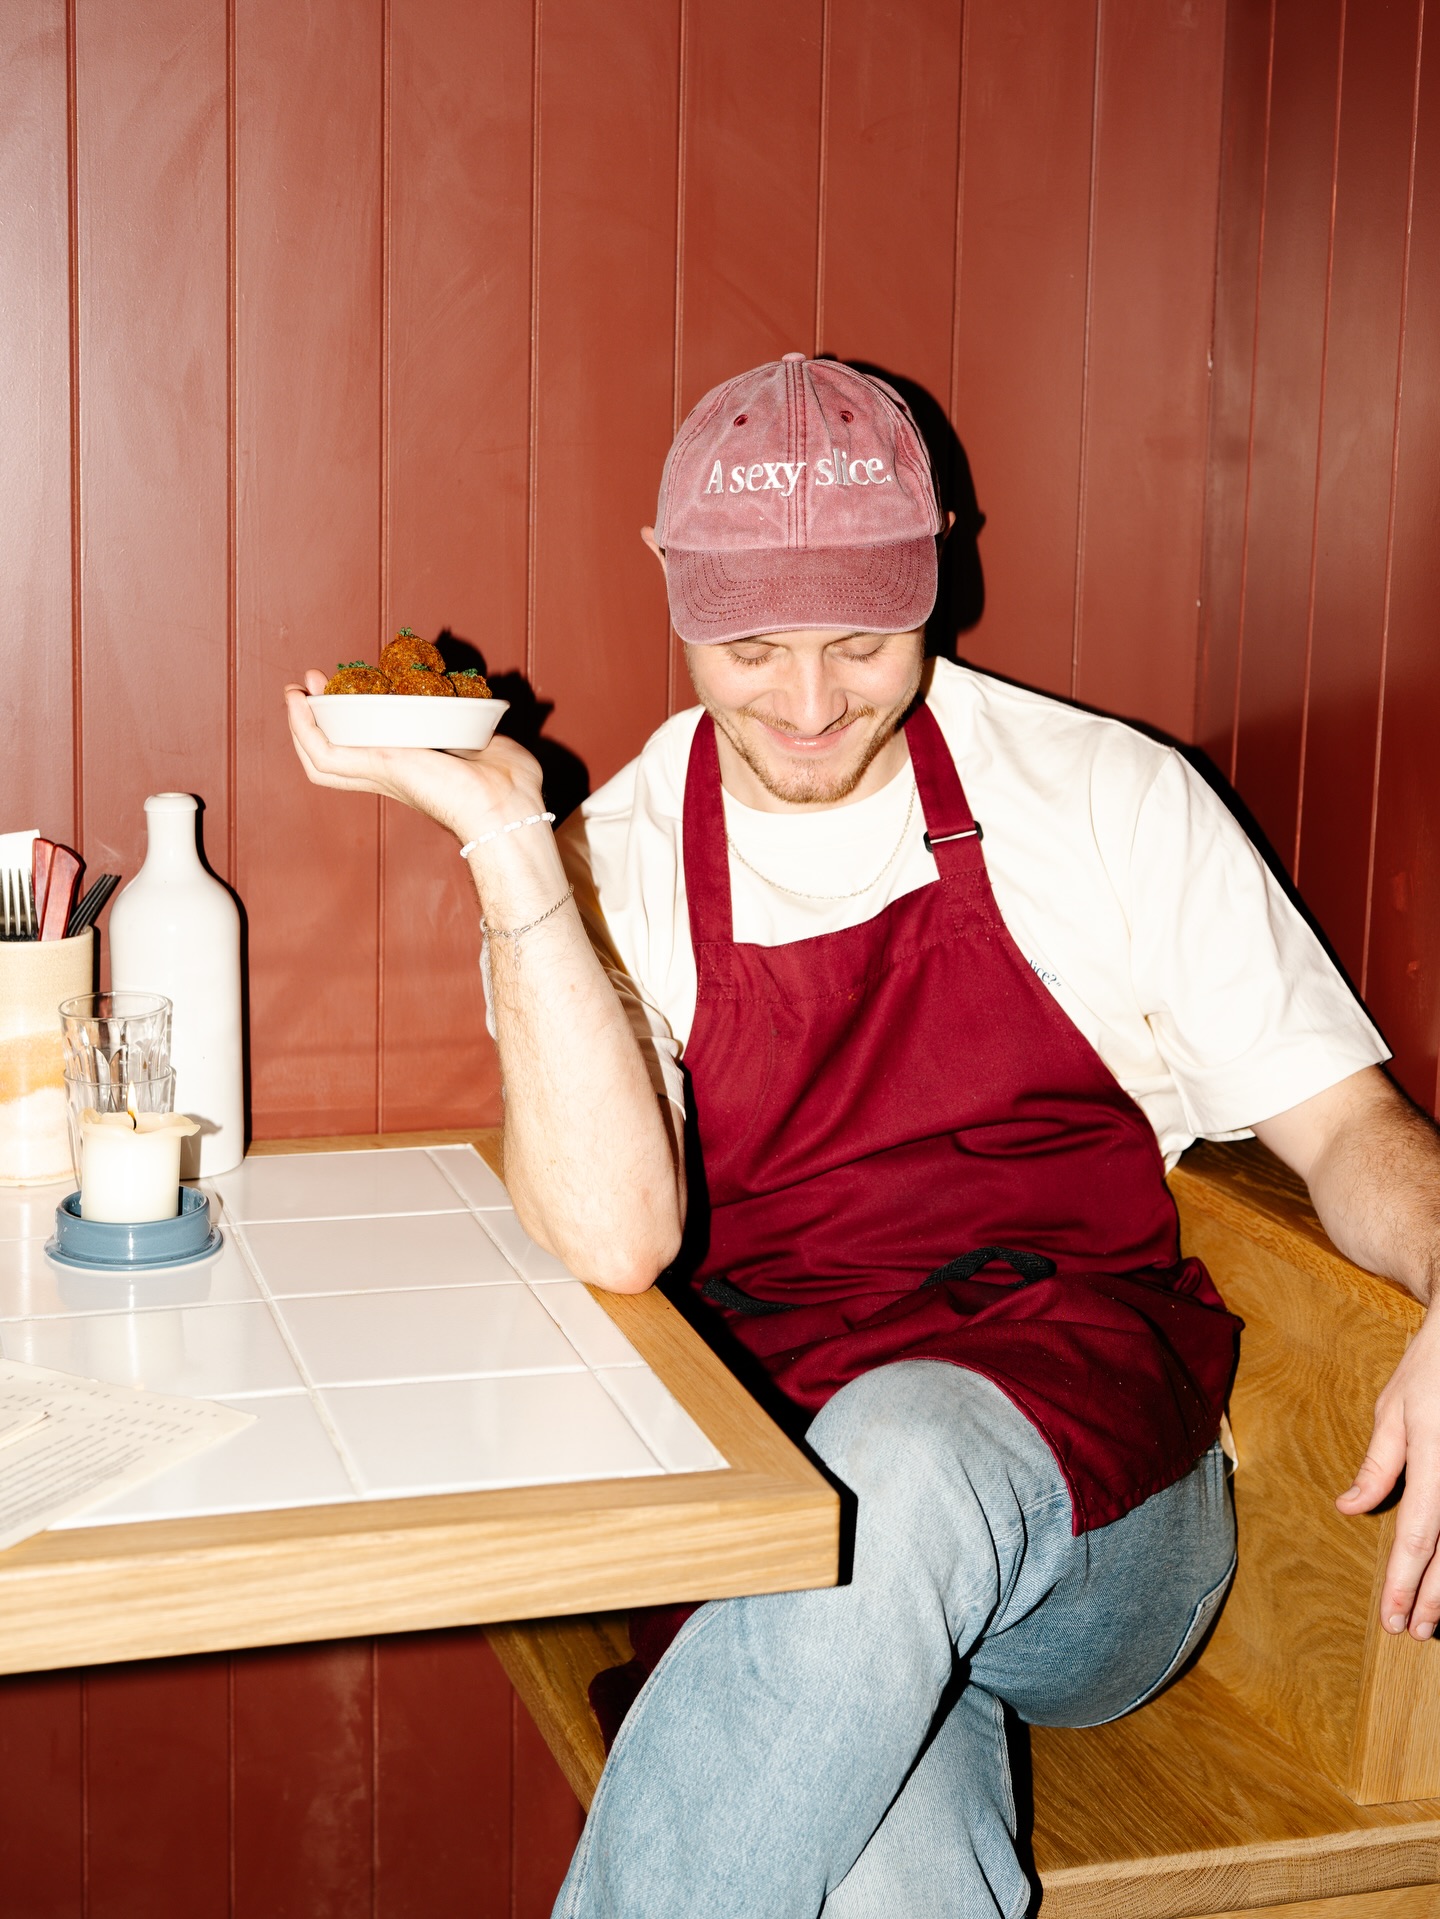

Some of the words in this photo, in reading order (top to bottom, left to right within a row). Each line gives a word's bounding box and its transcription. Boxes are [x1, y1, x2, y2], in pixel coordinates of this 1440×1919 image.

[704, 459, 725, 494] A
[729, 462, 807, 497] sexy
[815, 448, 892, 486] slice.
